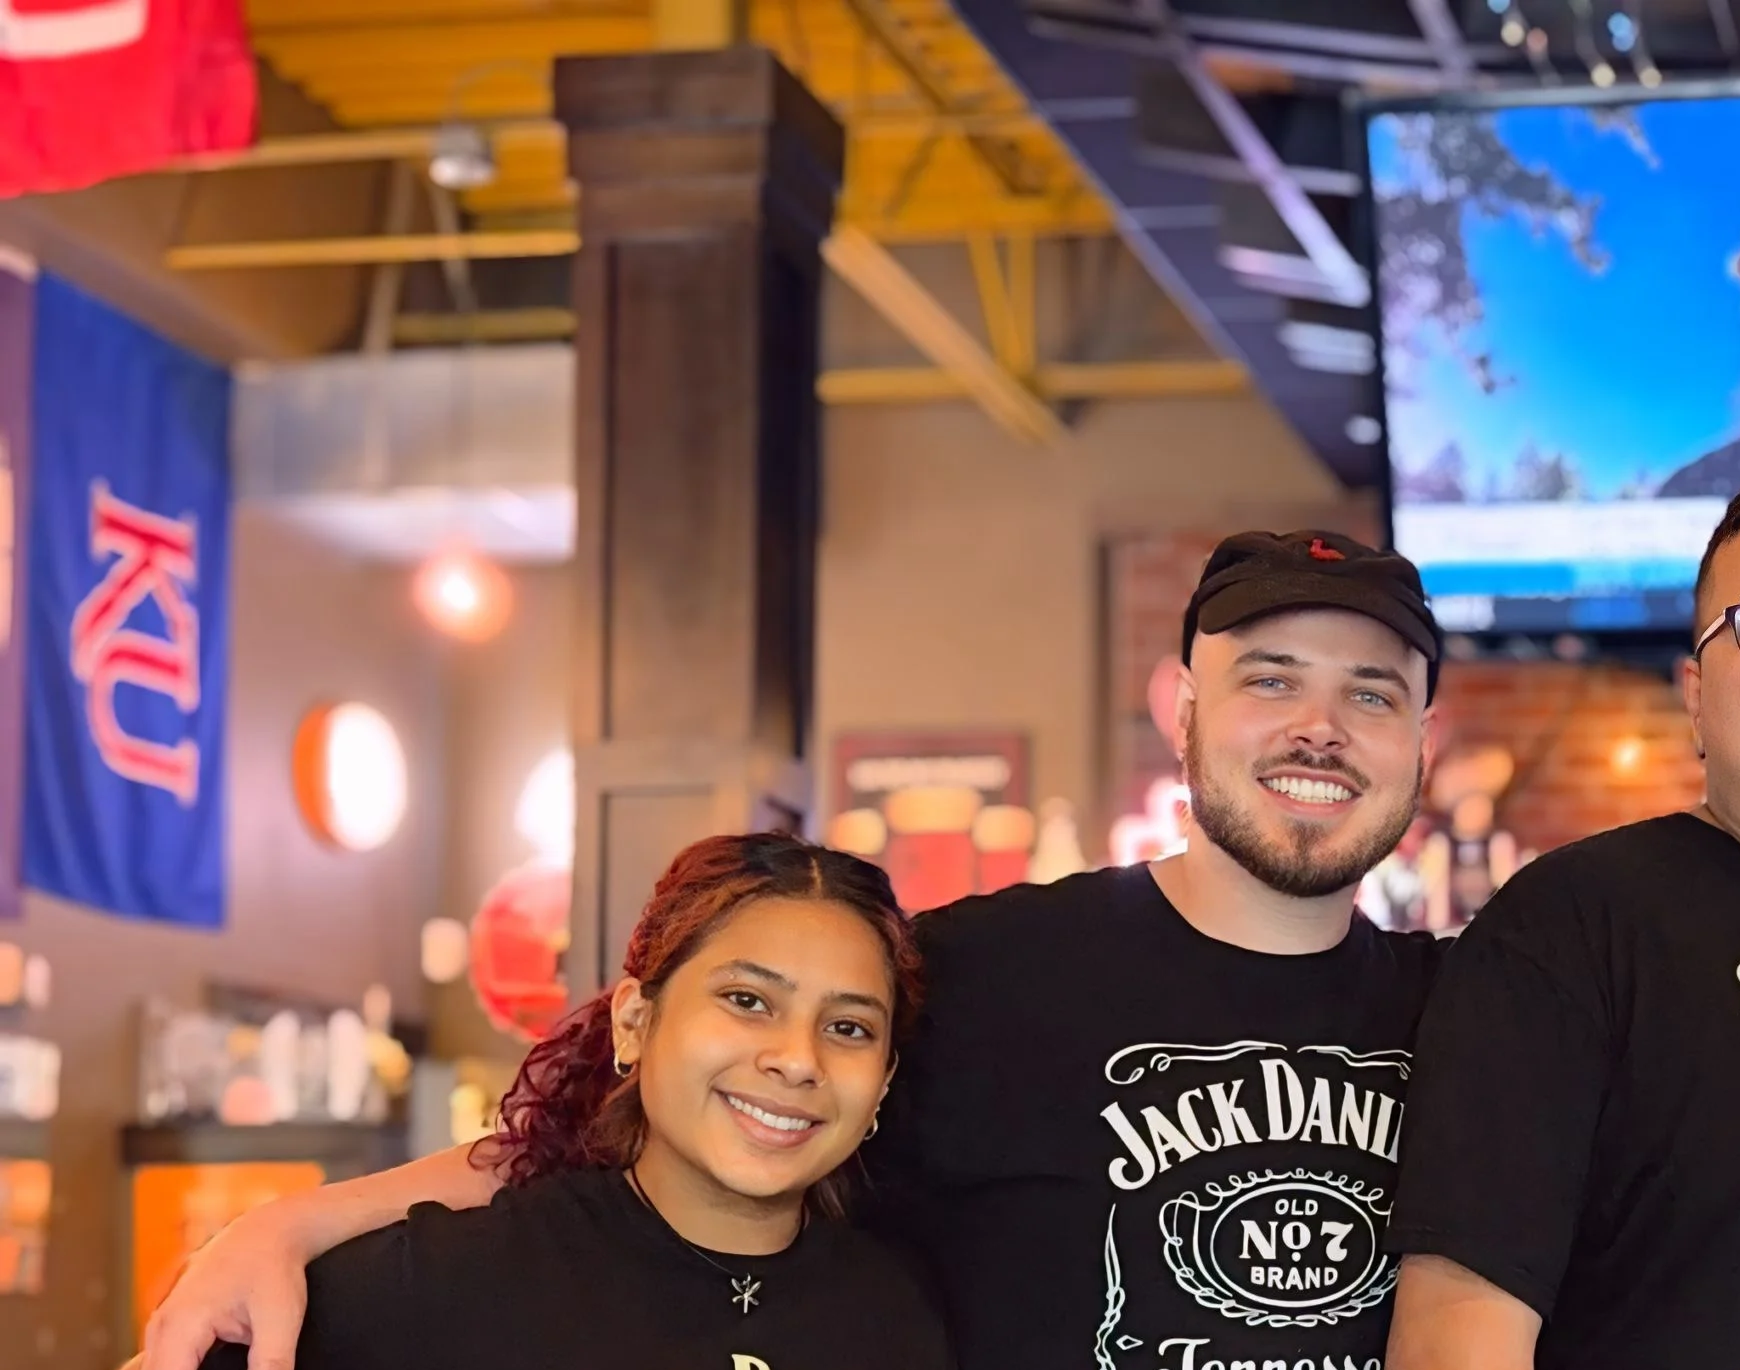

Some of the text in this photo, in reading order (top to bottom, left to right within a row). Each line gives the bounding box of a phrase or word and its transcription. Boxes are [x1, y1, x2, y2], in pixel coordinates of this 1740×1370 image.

[71, 474, 199, 808] KU
[1100, 1058, 1405, 1190] JACK DANI
[1275, 1198, 1319, 1216] OLD
[1250, 1266, 1339, 1290] BRAND
